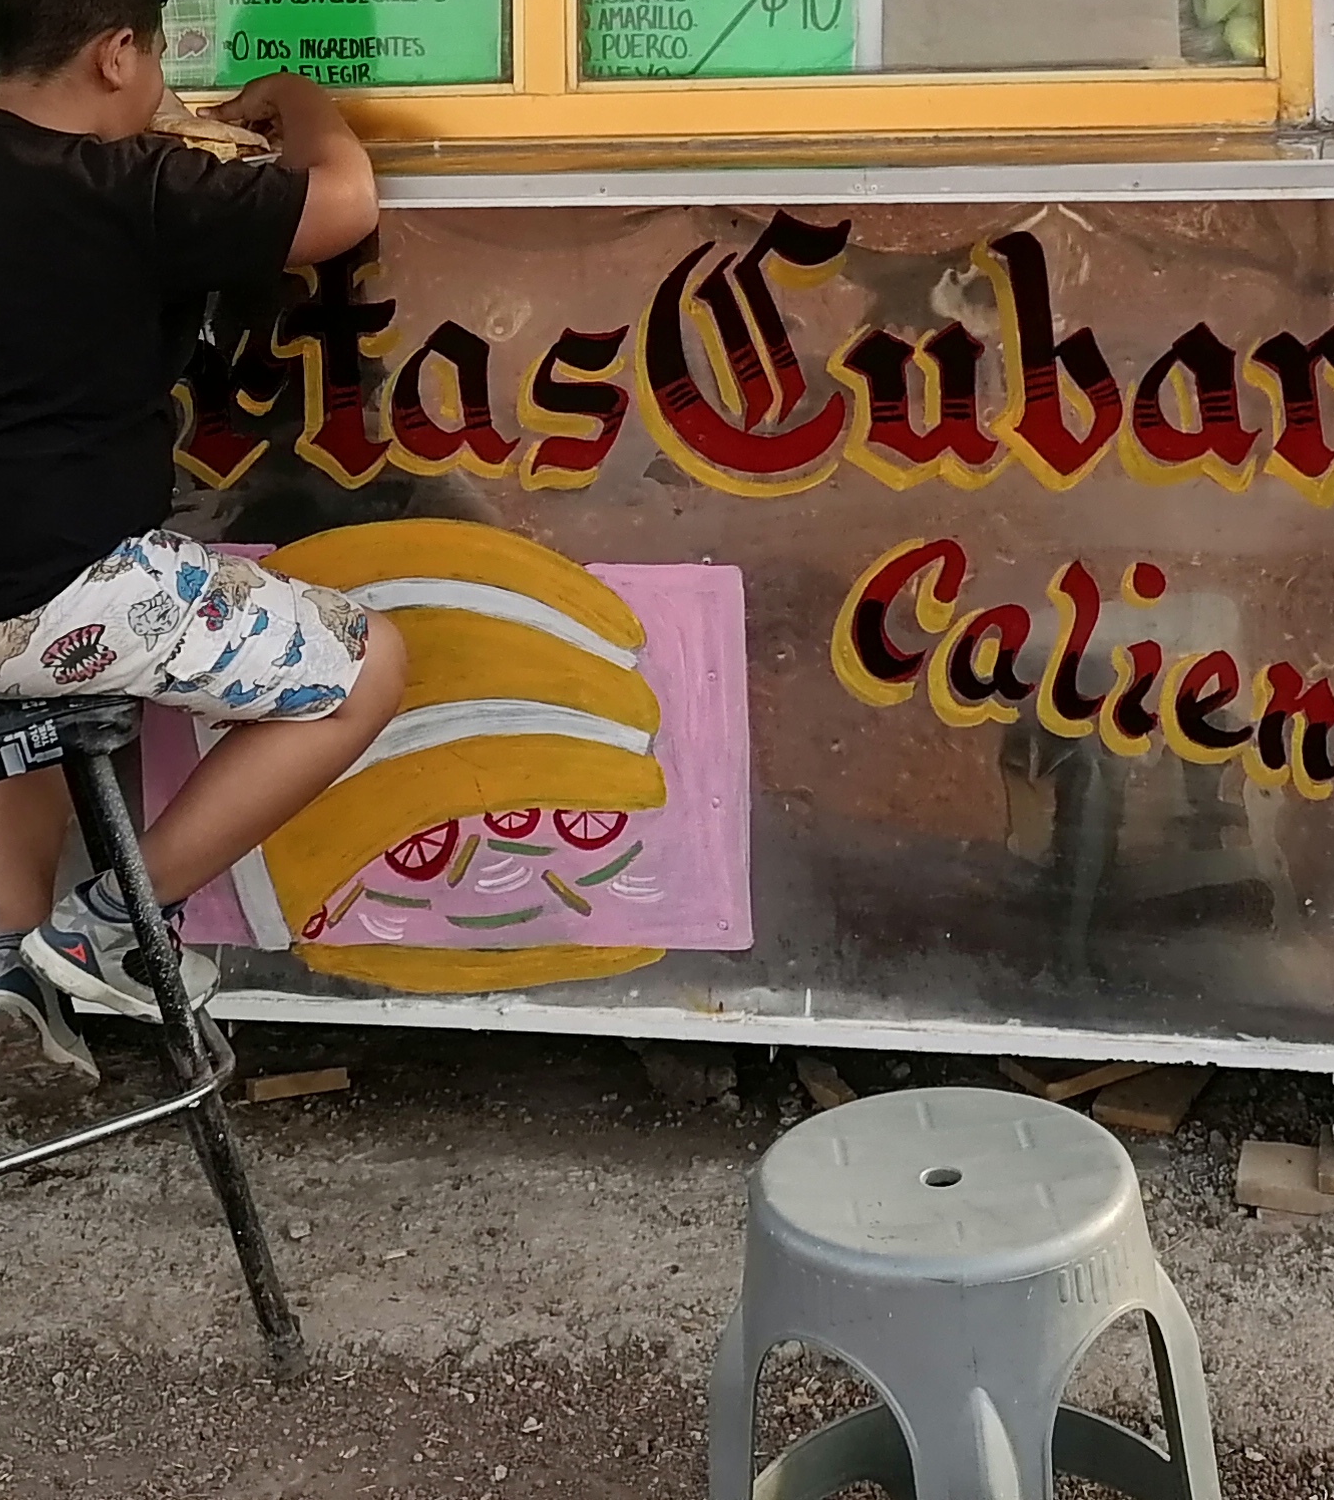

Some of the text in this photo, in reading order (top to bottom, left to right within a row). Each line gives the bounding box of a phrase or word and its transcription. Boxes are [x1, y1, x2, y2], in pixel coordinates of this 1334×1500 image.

[256, 38, 291, 60] DOS
[299, 36, 426, 59] INGREDIENTES
[171, 245, 630, 490] rtas
